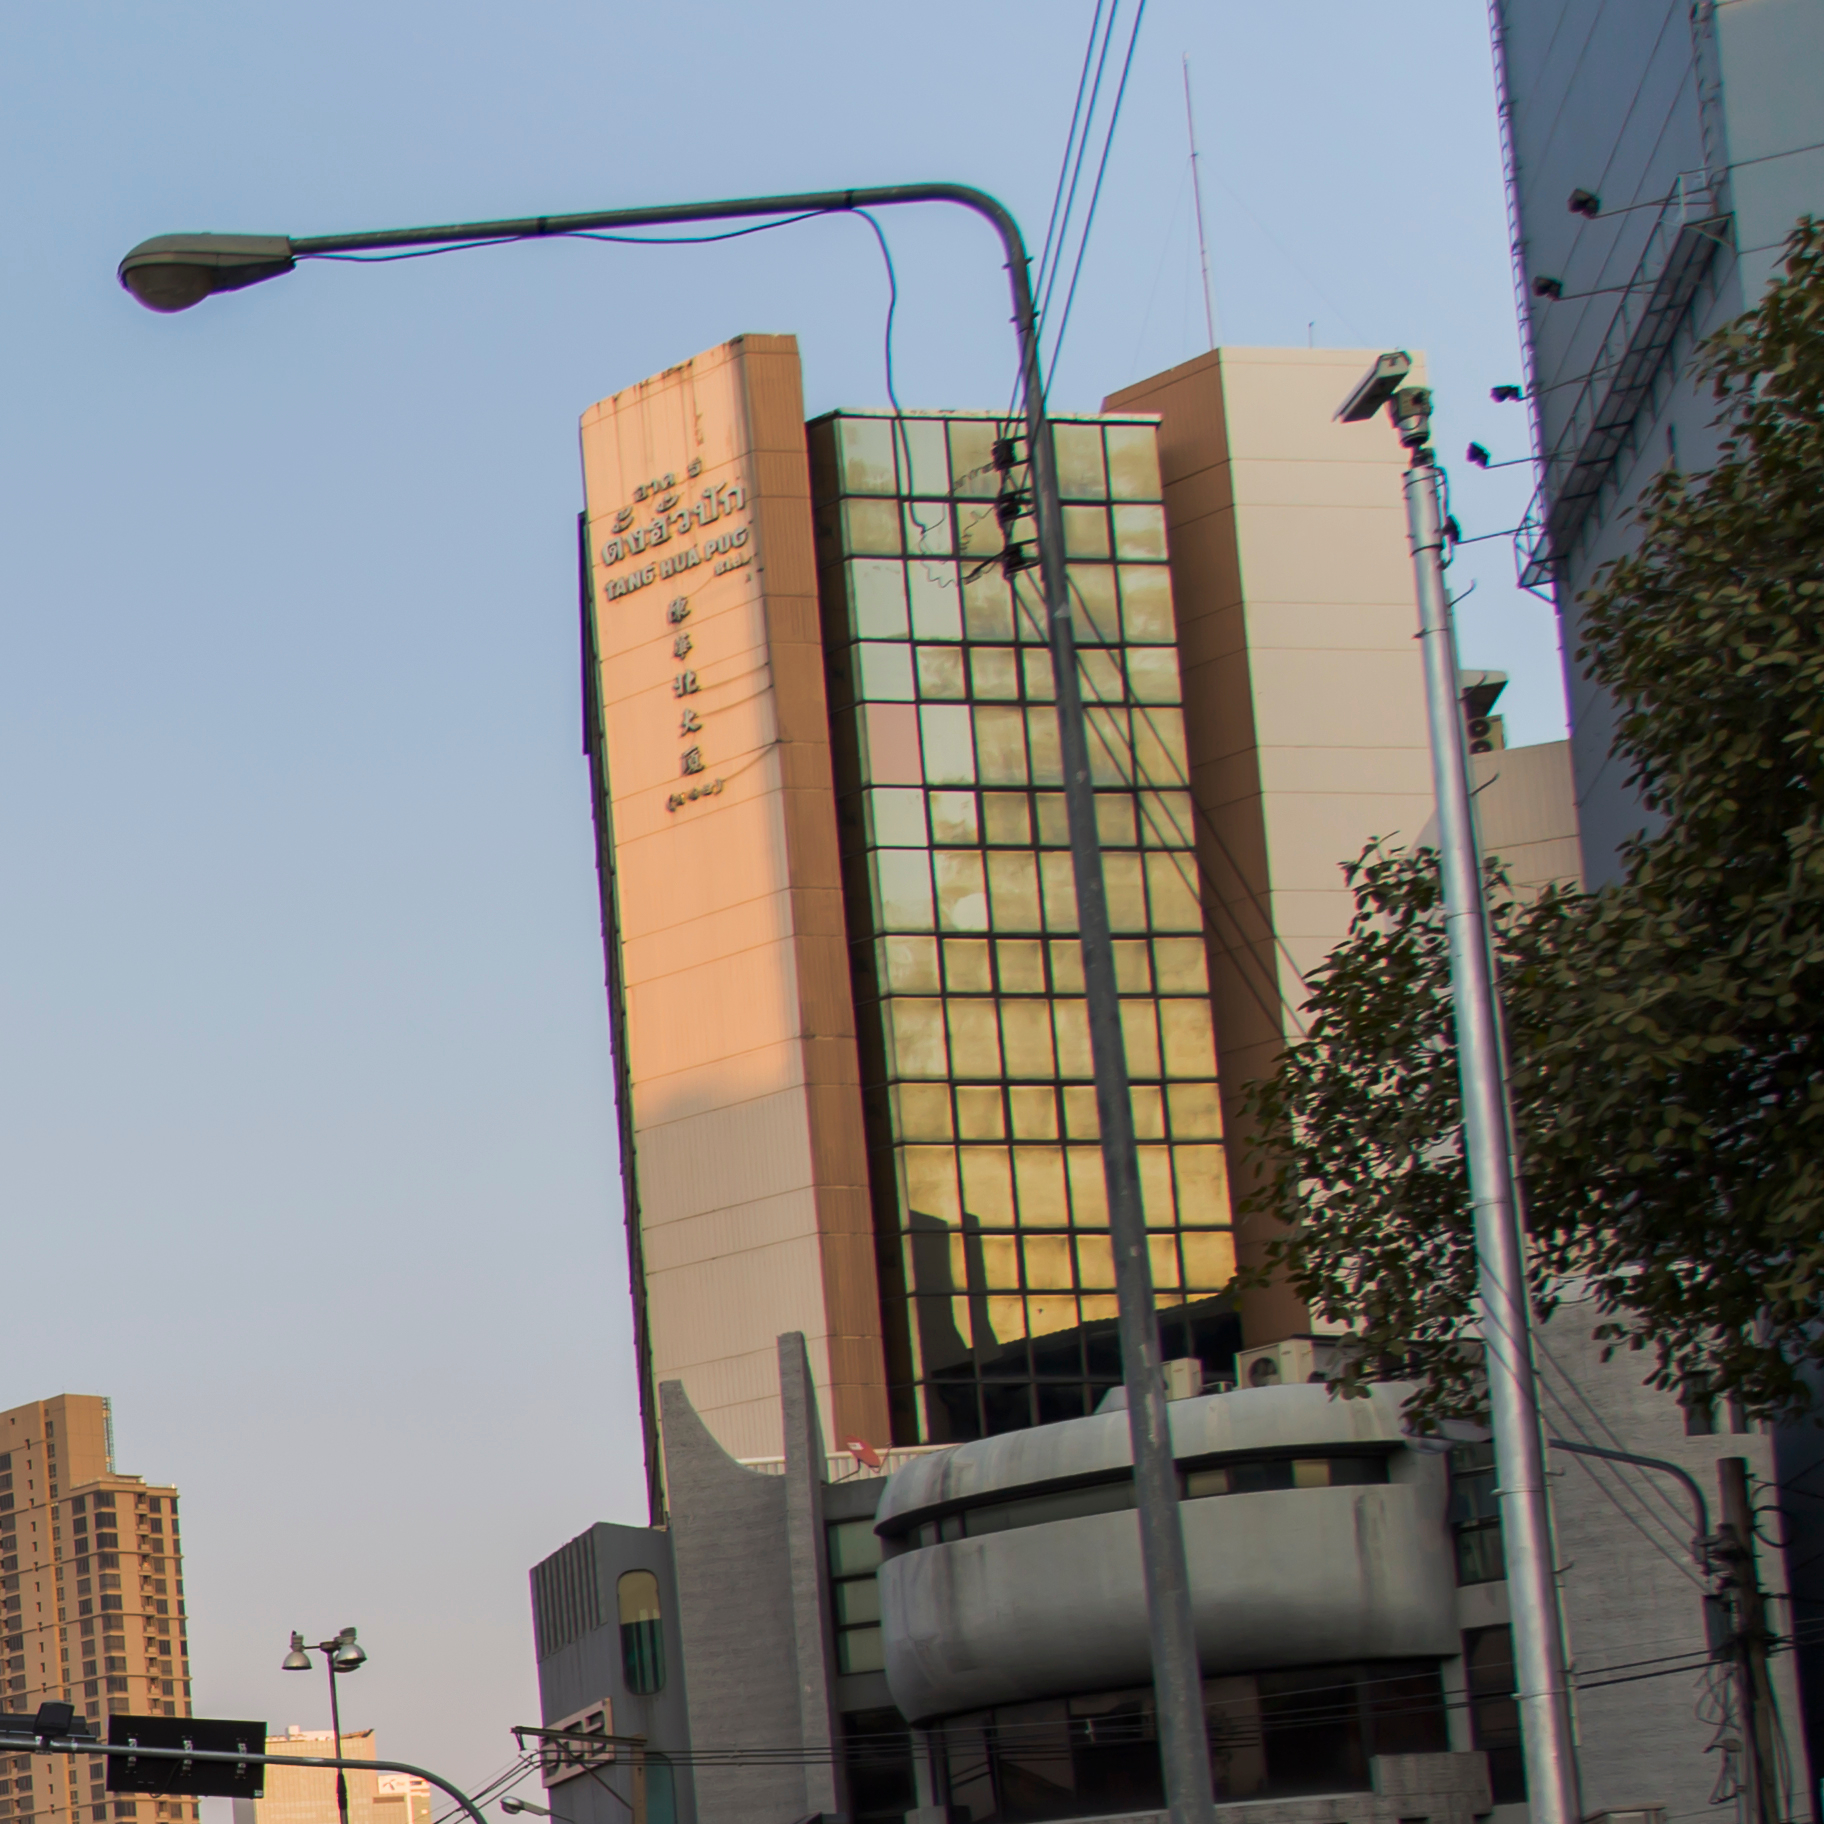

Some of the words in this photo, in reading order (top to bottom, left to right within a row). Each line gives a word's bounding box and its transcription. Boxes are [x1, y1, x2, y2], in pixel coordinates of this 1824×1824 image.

[605, 565, 656, 601] TANG
[659, 548, 701, 580] HUA
[704, 527, 748, 561] PUG
